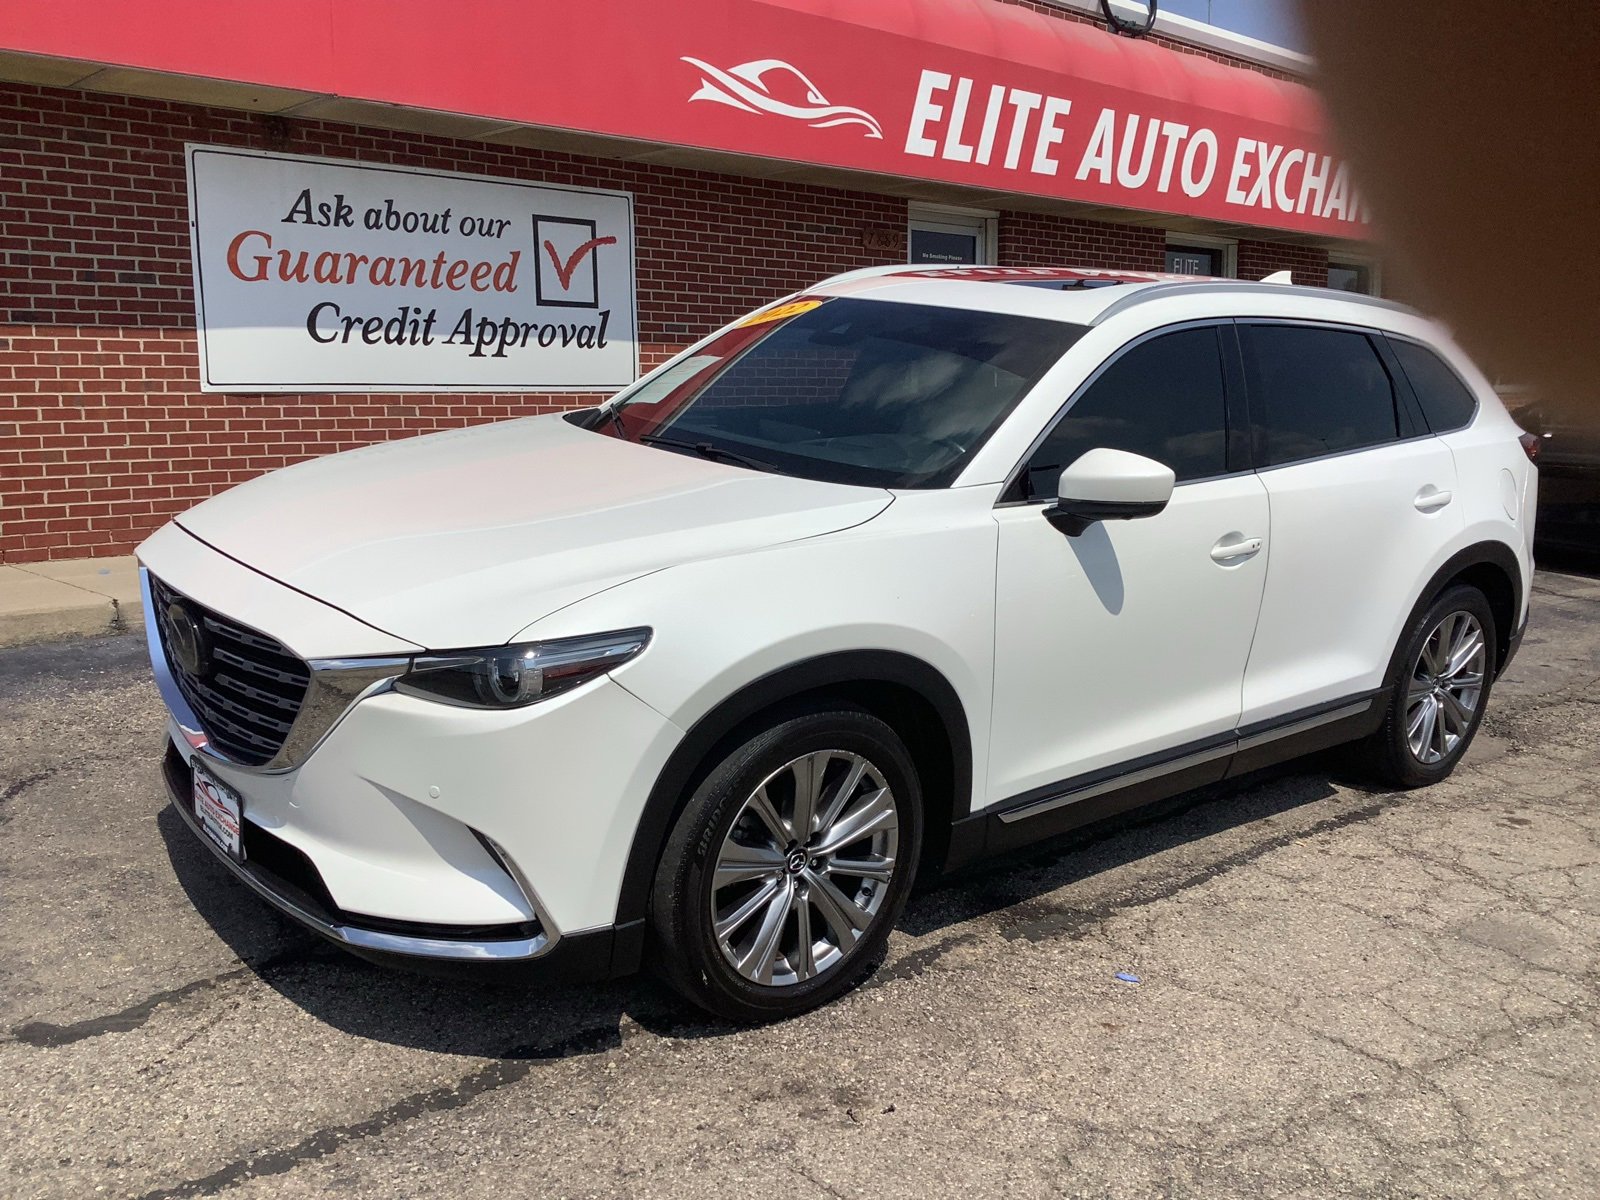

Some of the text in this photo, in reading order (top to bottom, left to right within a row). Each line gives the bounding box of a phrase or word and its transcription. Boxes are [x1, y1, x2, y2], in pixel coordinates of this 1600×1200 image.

[904, 69, 1072, 175] ELITE
[1075, 108, 1217, 197] AUTO
[281, 188, 512, 239] Ask about our
[226, 230, 521, 293] Guaranteed
[929, 253, 948, 261] Smoking
[1173, 258, 1199, 275] ELITE
[305, 301, 611, 358] Credit Approval
